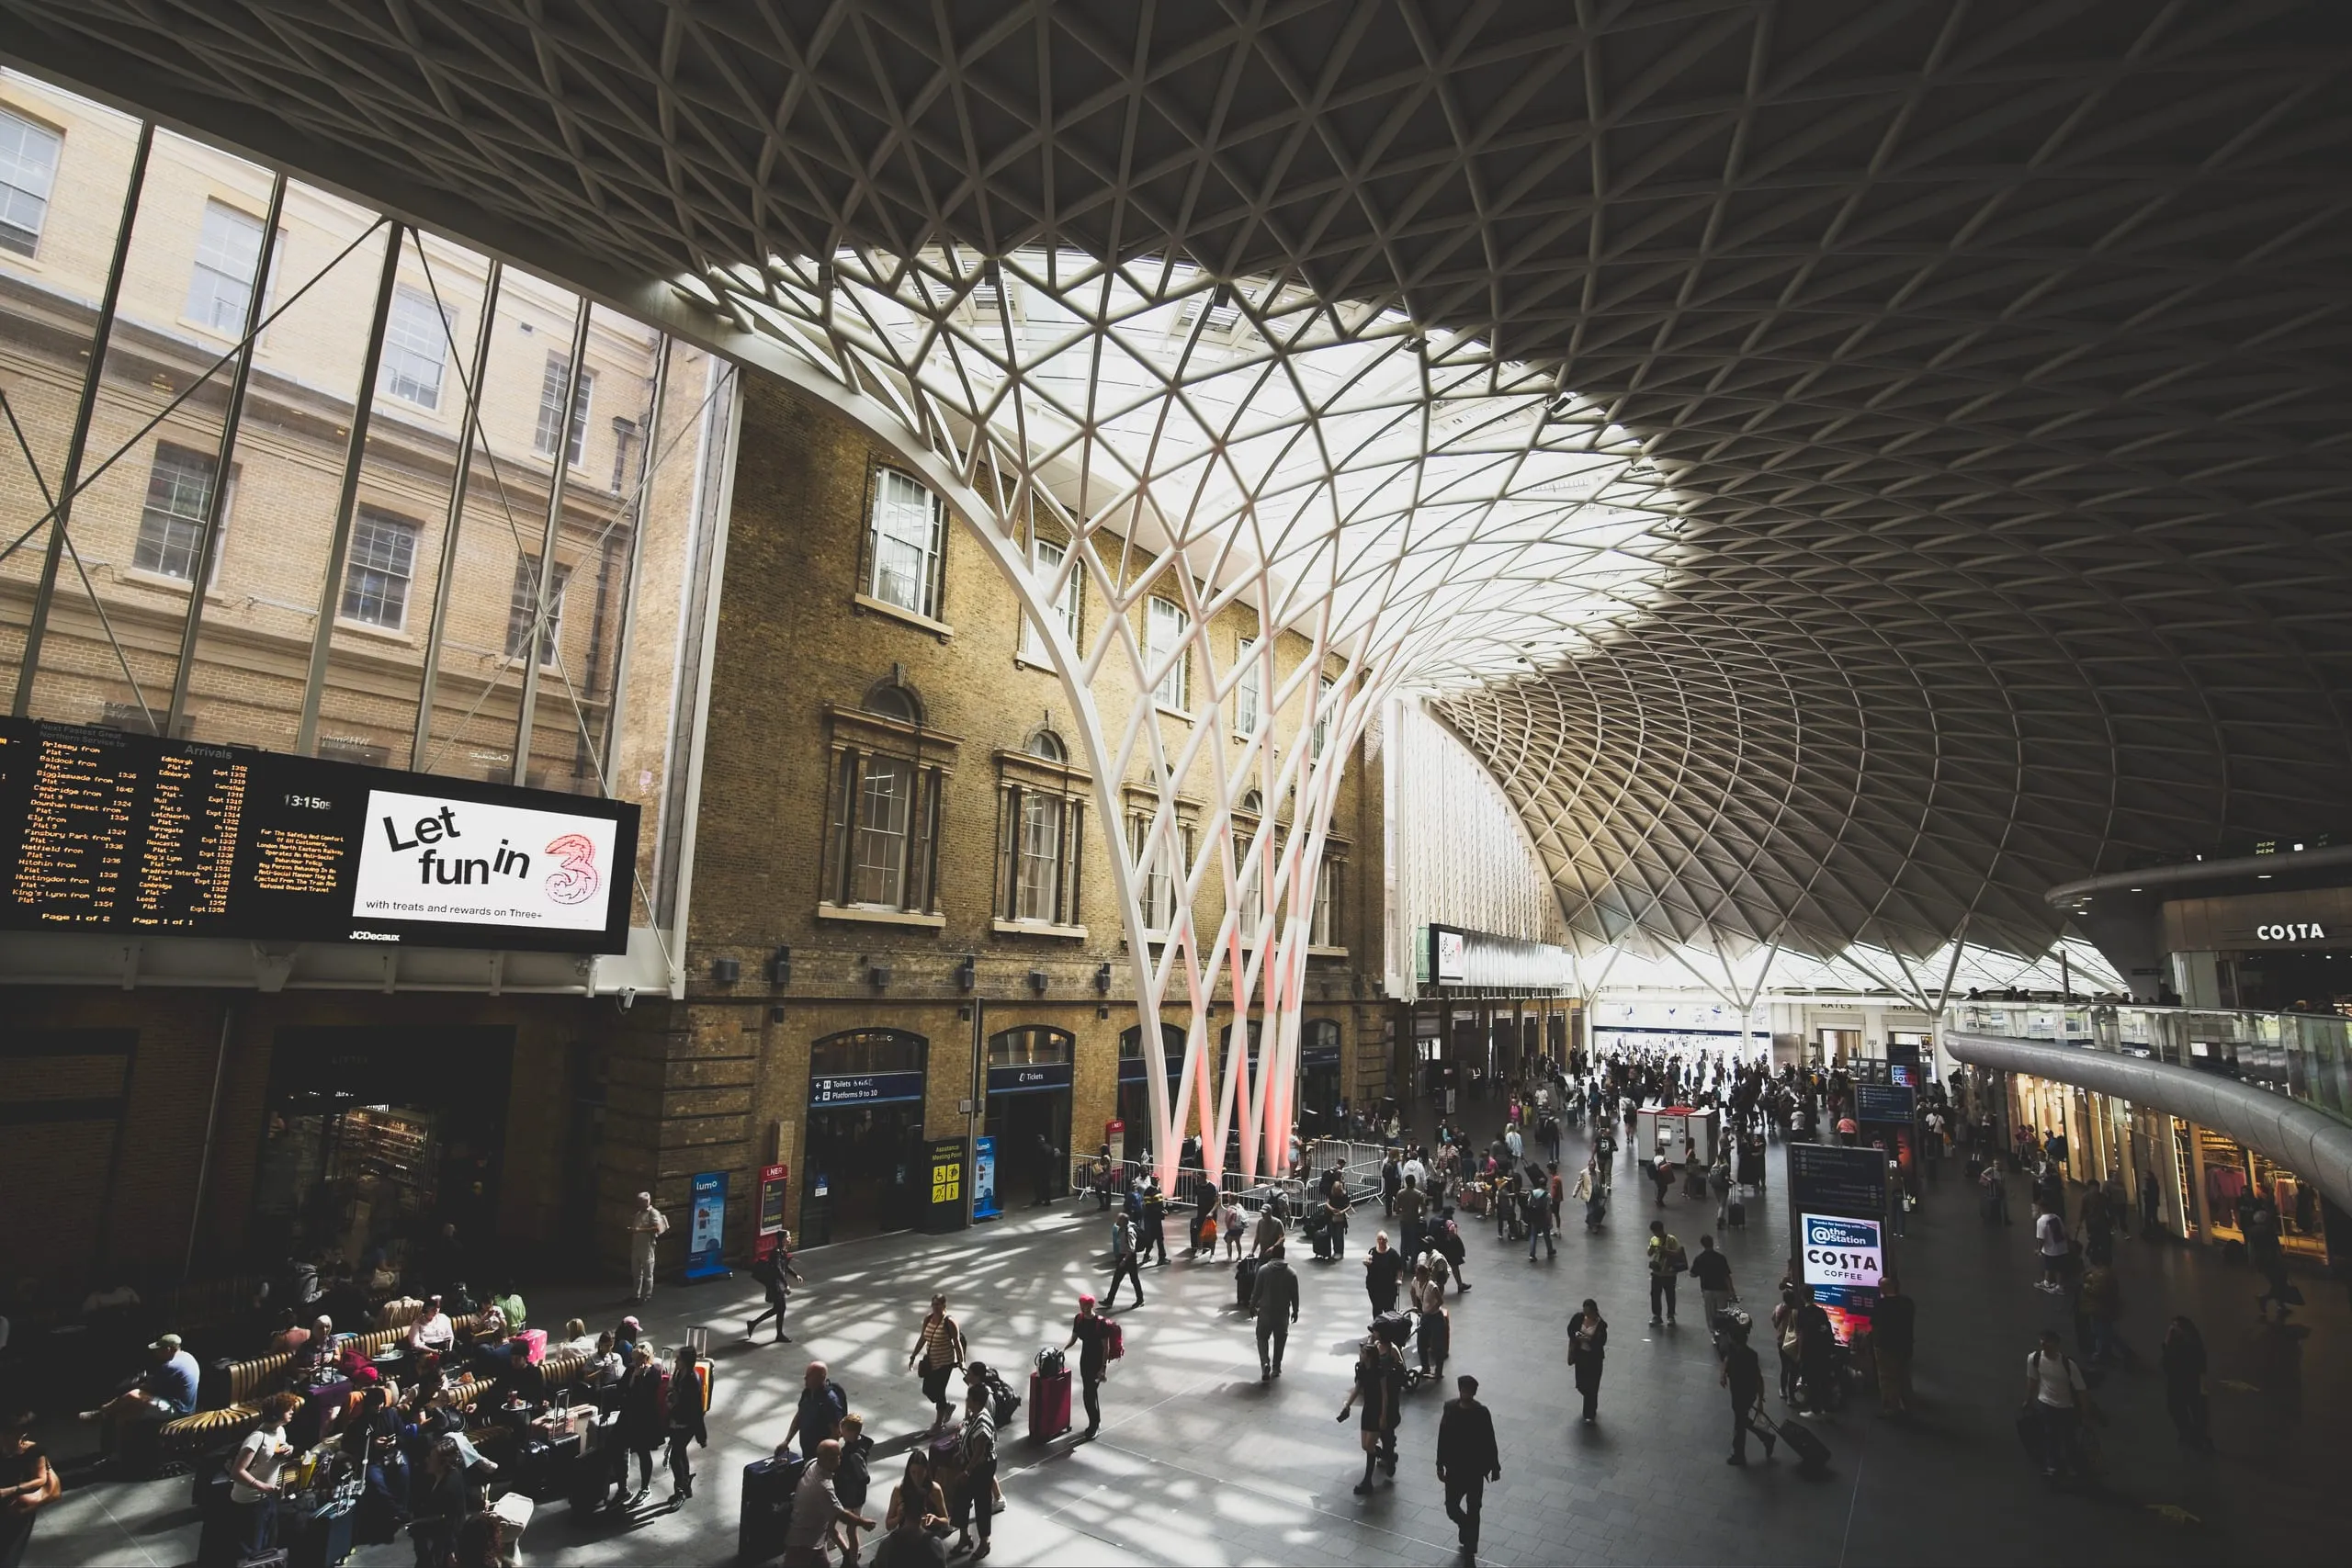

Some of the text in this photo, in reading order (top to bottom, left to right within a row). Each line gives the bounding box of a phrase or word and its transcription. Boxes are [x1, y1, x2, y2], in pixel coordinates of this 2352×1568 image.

[41, 723, 121, 739] Next Fastest Great
[40, 731, 79, 742] Northern
[82, 736, 113, 747] Service
[42, 741, 77, 751] Arlesey
[185, 745, 233, 760] Arrivals
[39, 755, 73, 764] Baldock
[25, 829, 65, 838] Finsbury
[383, 806, 460, 852] Let
[418, 839, 531, 885] fun in
[15, 874, 66, 882] Huntingdon
[366, 900, 389, 909] with
[393, 901, 424, 912] treats
[428, 904, 447, 913] and
[450, 907, 491, 916] rewards
[349, 931, 400, 941] JCDecaux
[2257, 923, 2325, 942] COSTA
[832, 1091, 858, 1099] Platforms
[767, 1167, 783, 1176] LNER
[696, 1181, 717, 1190] lumo
[1811, 1227, 1830, 1244] @
[1830, 1235, 1866, 1244] Station
[1808, 1250, 1878, 1271] COSTA
[1824, 1270, 1862, 1280] COFFEE
